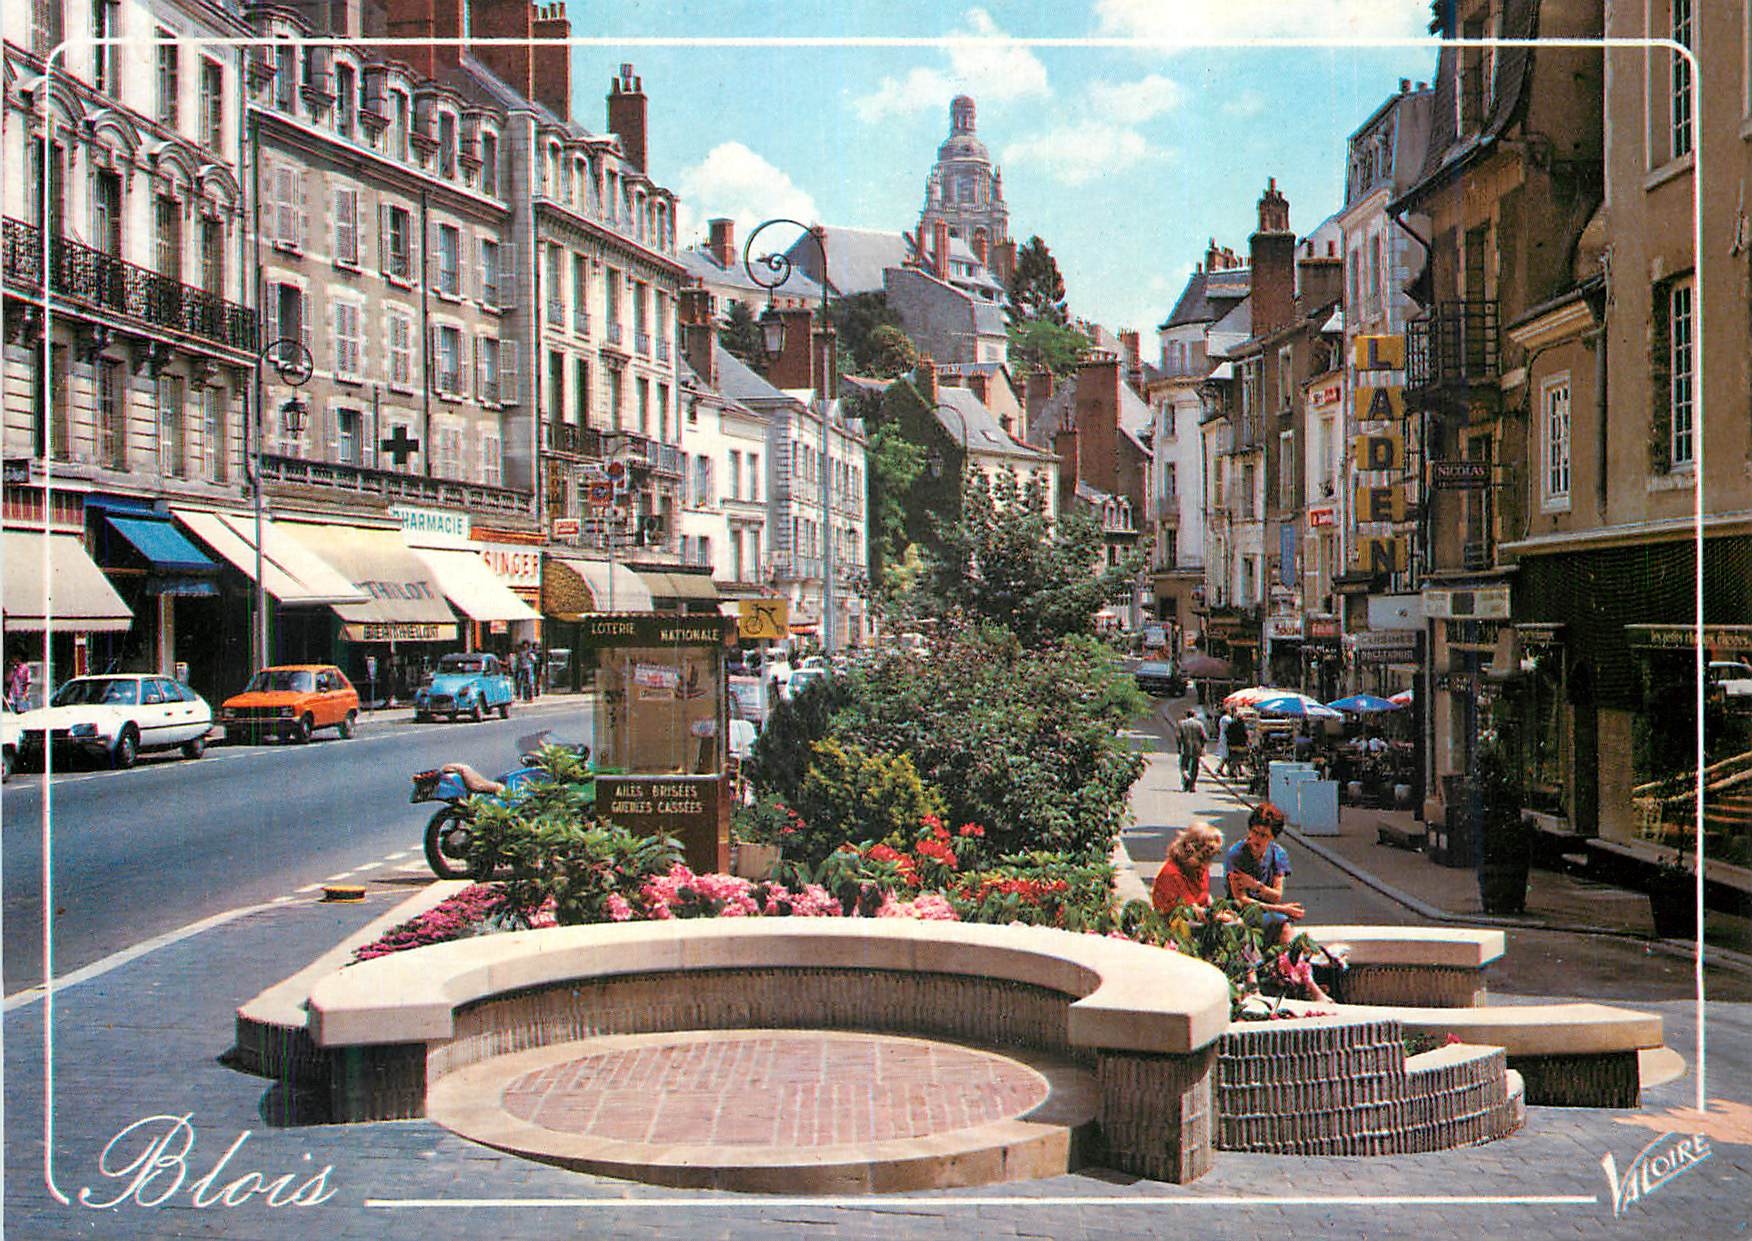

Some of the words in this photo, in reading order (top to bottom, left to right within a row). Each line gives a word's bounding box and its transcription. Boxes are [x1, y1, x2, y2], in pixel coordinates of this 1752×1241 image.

[1367, 338, 1396, 573] LADEN
[1438, 465, 1485, 477] NICOLAS
[392, 508, 463, 535] PHARMACIE
[483, 550, 540, 577] SINGER
[363, 624, 440, 641] BERTHELOT
[591, 623, 636, 635] LOTERIE
[660, 629, 720, 642] NATIONALE
